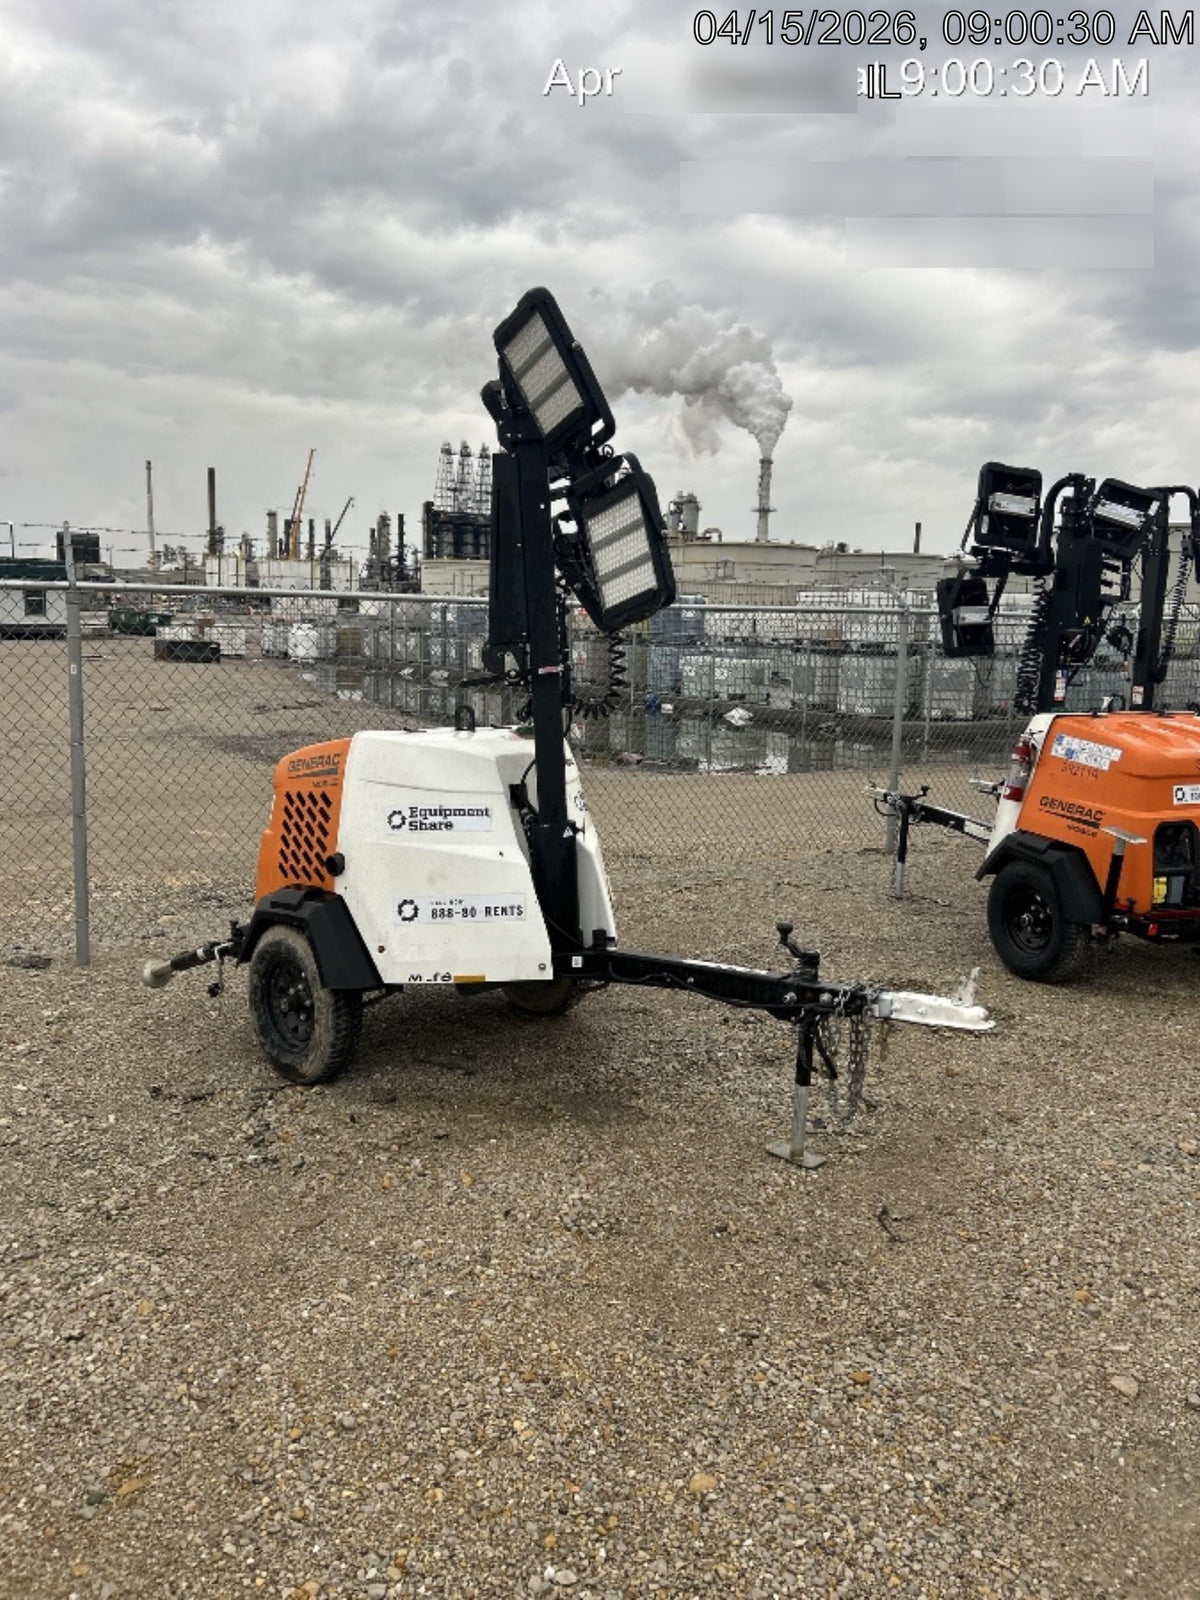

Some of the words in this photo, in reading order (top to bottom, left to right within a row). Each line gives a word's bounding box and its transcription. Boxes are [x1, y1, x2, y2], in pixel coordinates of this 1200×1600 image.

[408, 804, 491, 821] Equipment
[1039, 795, 1105, 822] GENERAC
[408, 820, 454, 831] Share
[484, 904, 524, 918] RENTS
